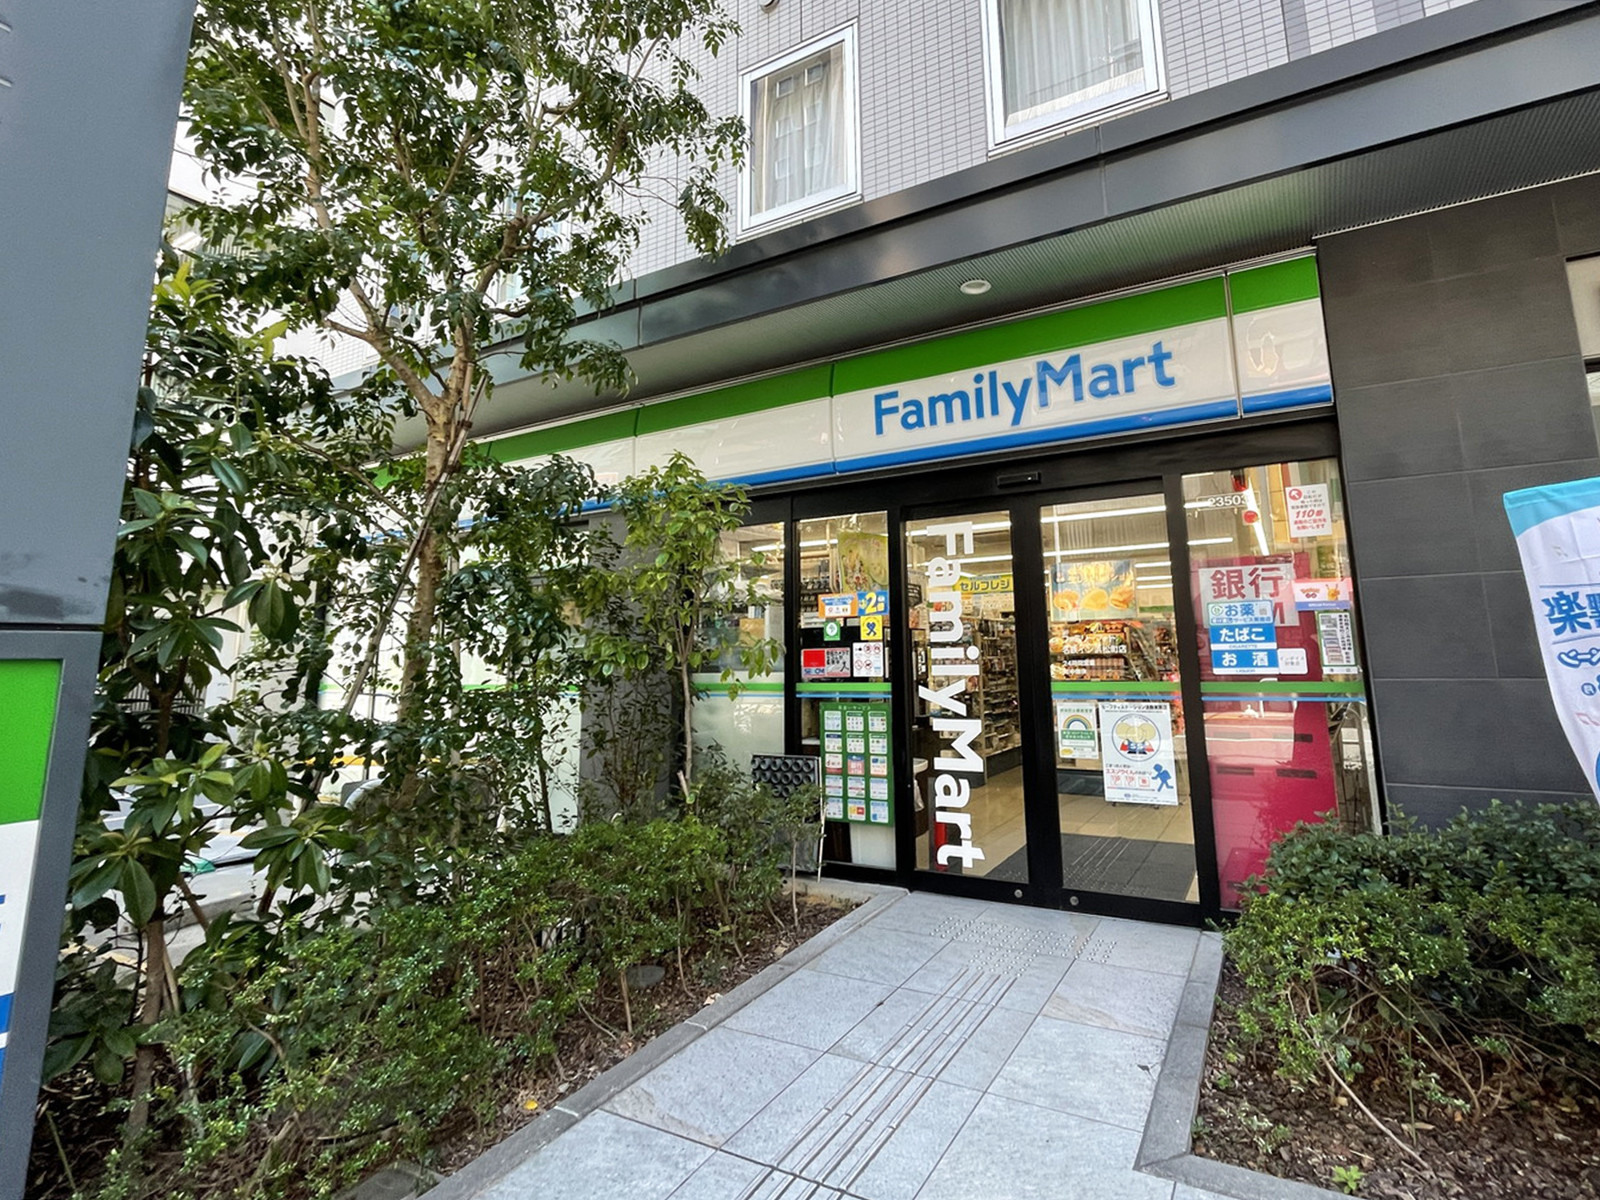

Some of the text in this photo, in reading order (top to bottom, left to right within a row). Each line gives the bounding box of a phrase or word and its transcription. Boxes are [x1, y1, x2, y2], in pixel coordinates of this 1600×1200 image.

[874, 341, 1175, 436] FamilyMart
[960, 579, 1010, 592] セルフレジ
[1210, 567, 1284, 600] 銀行
[1225, 603, 1255, 617] お薬
[1219, 627, 1265, 642] たばこ
[918, 521, 985, 868] FamilyMart
